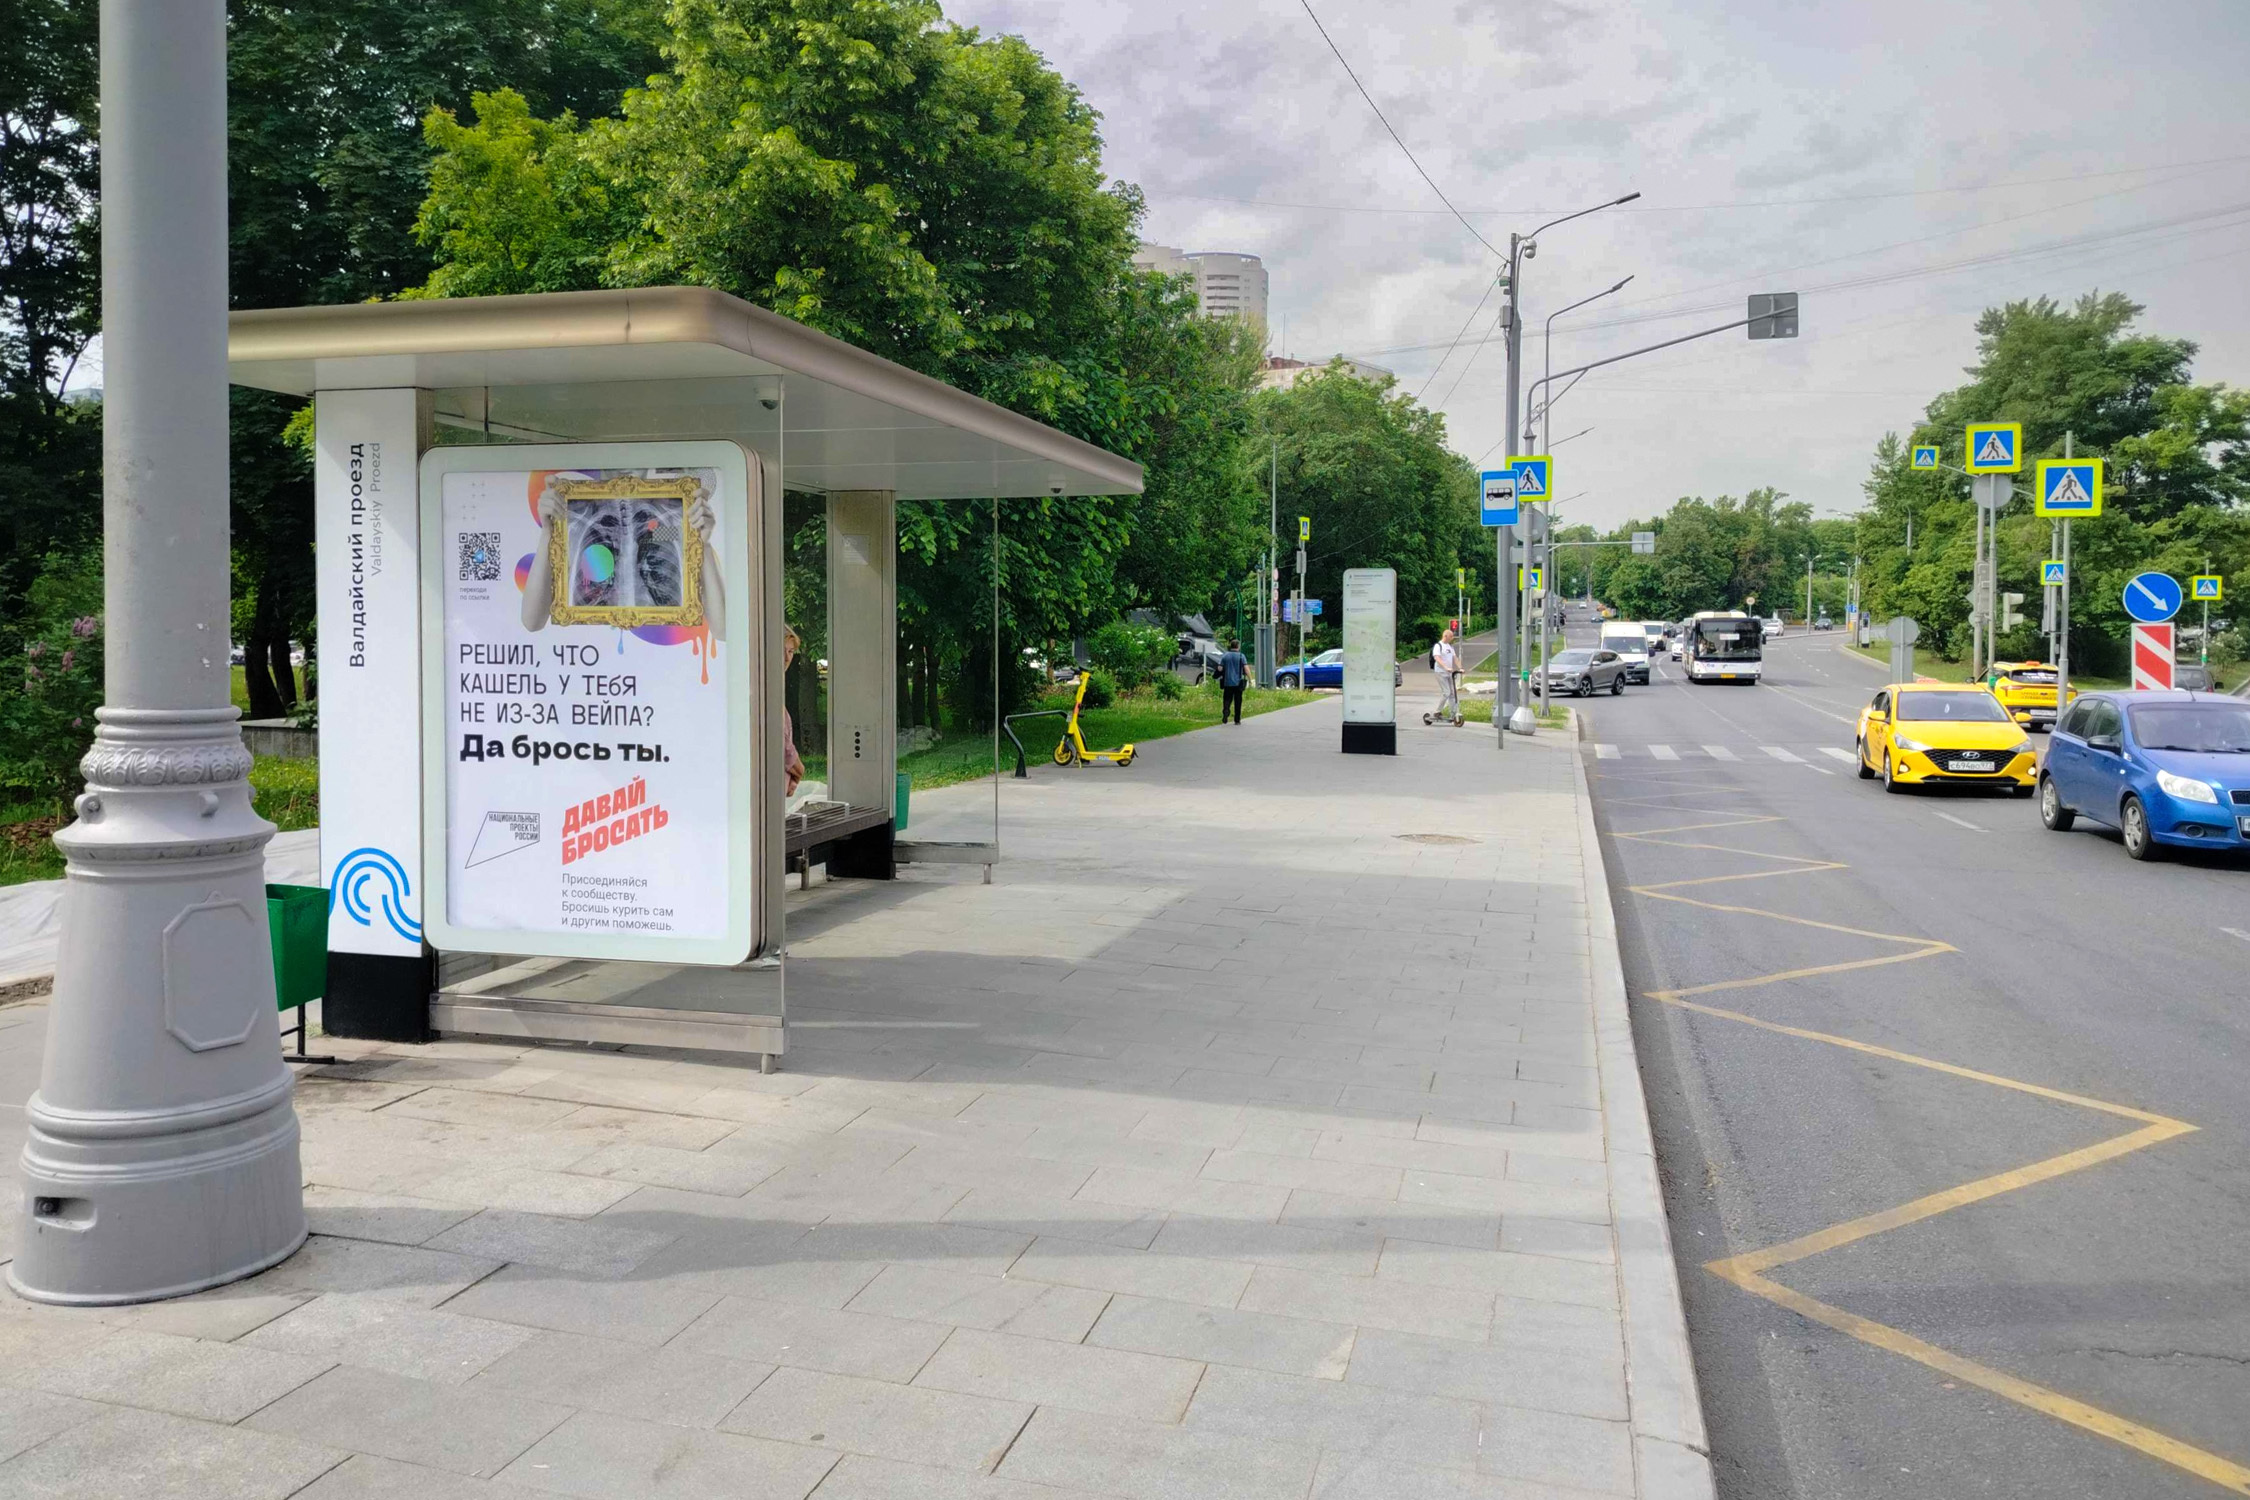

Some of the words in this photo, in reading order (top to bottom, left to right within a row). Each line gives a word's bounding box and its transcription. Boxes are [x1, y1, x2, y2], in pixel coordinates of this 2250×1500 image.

[370, 442, 381, 492] Proezd
[350, 443, 366, 526] проезд
[370, 500, 384, 577] Valdayskiy
[348, 533, 367, 668] Валдайский
[460, 643, 541, 668] РЕШИЛ,
[553, 645, 600, 666] ЧТО
[460, 673, 547, 695] КАШЕЛЬ
[559, 674, 571, 695] У
[461, 702, 485, 722] НЕ
[497, 702, 559, 724] ИЗ-ЗА
[572, 700, 655, 726] ВЕЙПА?
[460, 734, 505, 762] Да
[511, 735, 611, 766] брось
[617, 743, 670, 762] ты.
[488, 813, 538, 824] НАЦИОНАЛЬНЫЕ
[562, 775, 646, 838] ДАВАЙ
[509, 823, 538, 832] ПРОЕКТЫ
[514, 832, 538, 841] РОССИИ
[562, 804, 669, 866] БРОСАТЬ
[562, 873, 648, 888] Присоединяйся
[562, 889, 568, 898] к
[571, 888, 638, 903] сообществу.
[562, 901, 610, 914] Бросишь
[612, 906, 650, 917] курить
[652, 907, 674, 917] сам
[561, 917, 568, 925] и
[570, 917, 610, 929] другим
[612, 919, 675, 932] поможешь.
